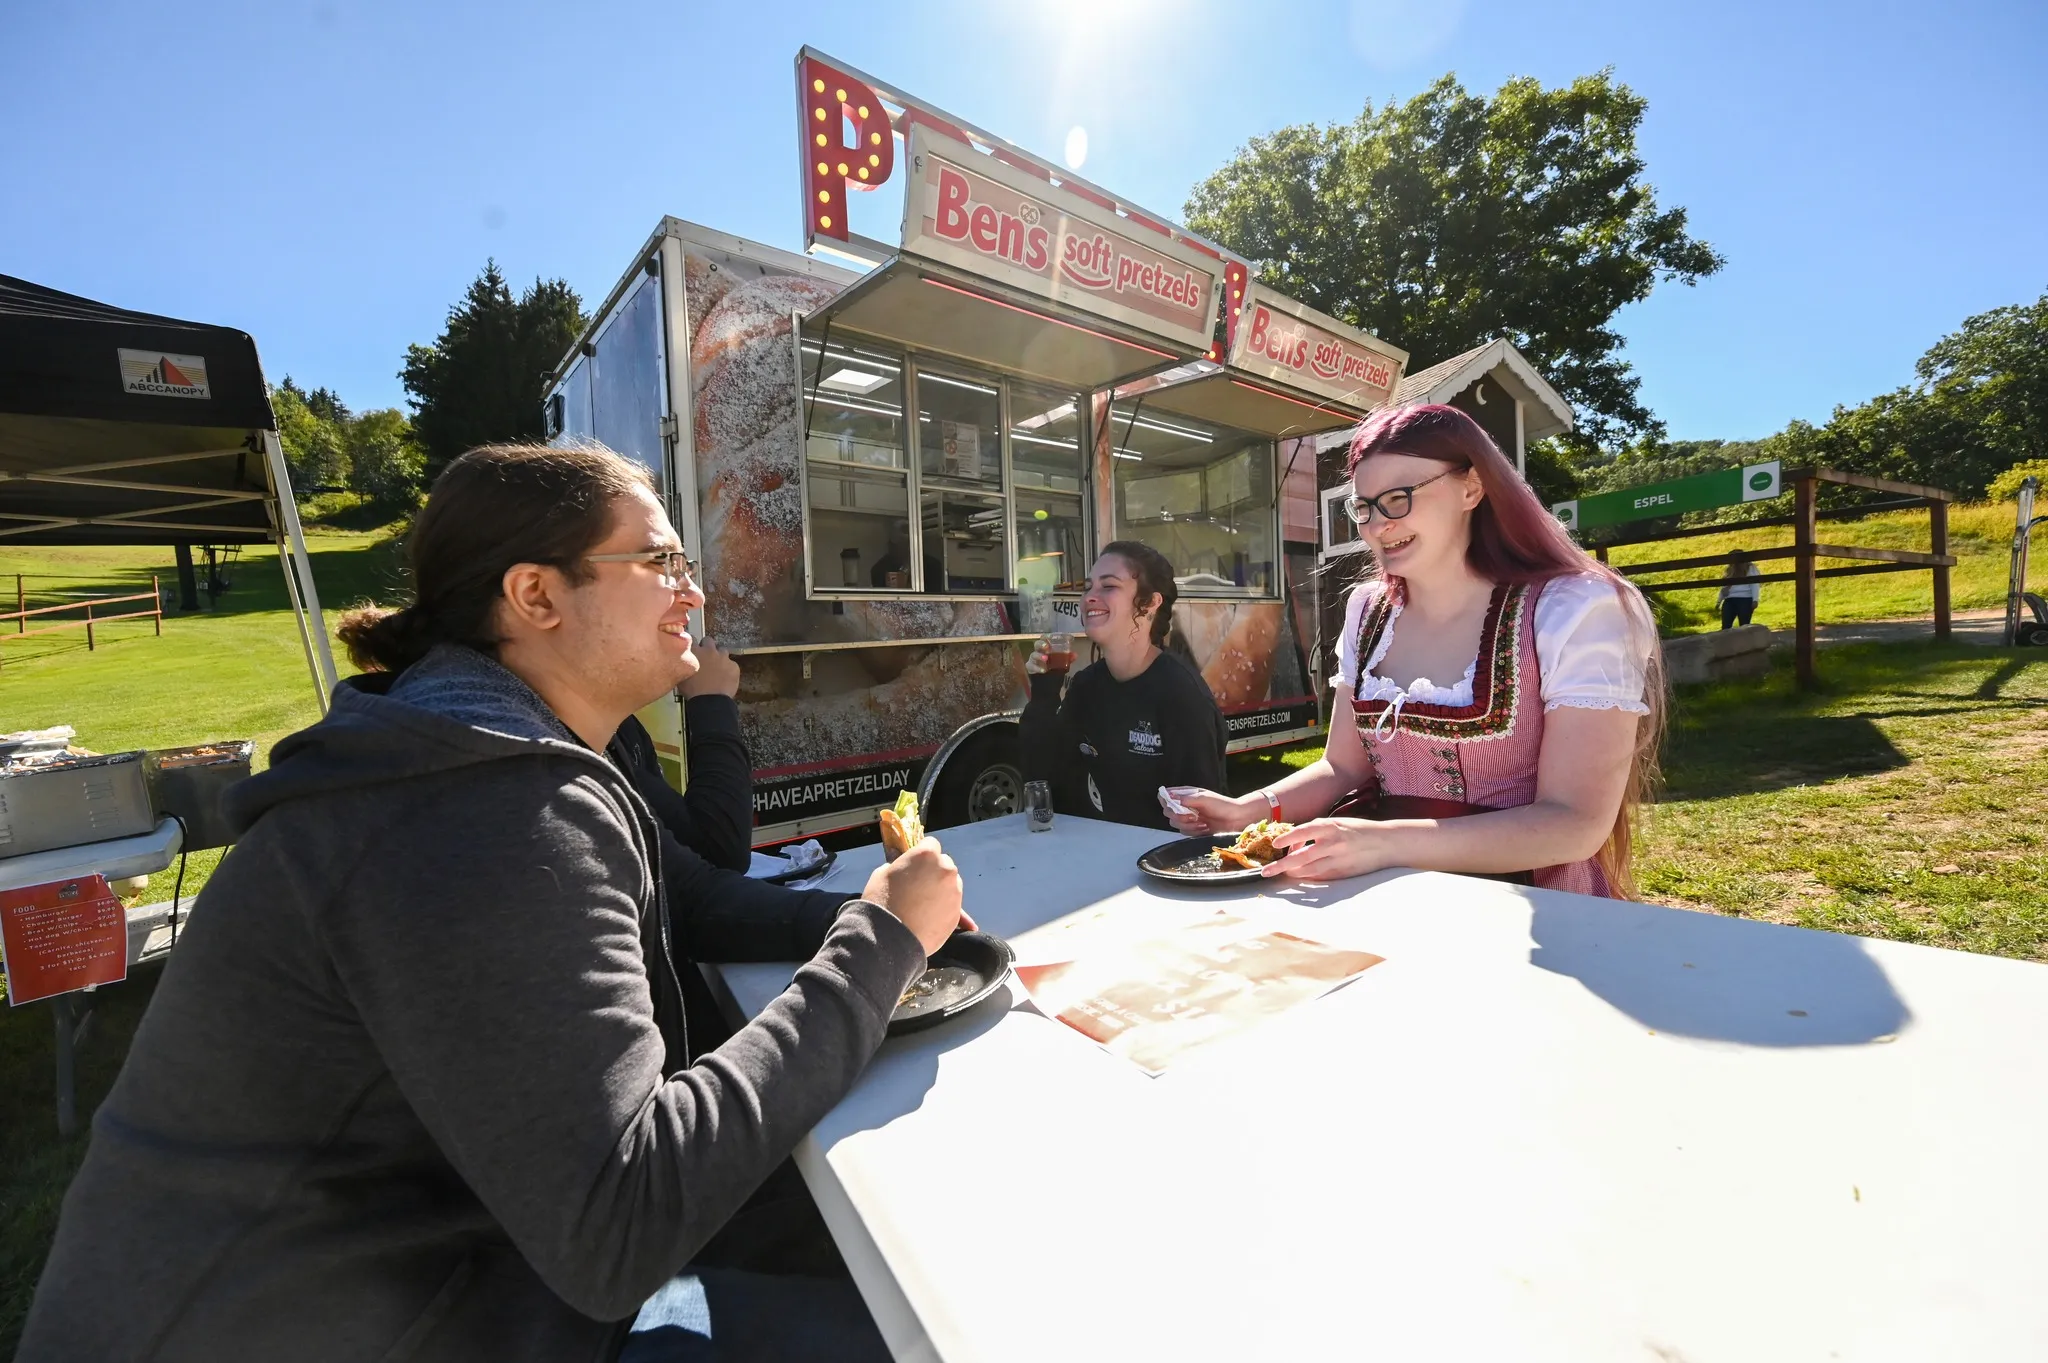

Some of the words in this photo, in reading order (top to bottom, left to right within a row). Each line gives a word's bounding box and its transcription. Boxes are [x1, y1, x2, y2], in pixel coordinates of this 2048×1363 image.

[1063, 233, 1112, 275] soft
[1115, 253, 1201, 310] pretzels
[1314, 340, 1343, 370] soft
[1341, 355, 1390, 388] pretzels
[129, 382, 205, 396] ABCCANOPY
[1633, 493, 1674, 510] ESPEL
[13, 905, 36, 915] FOOD
[25, 909, 68, 921] Hamburger
[57, 913, 83, 922] Burger
[47, 921, 79, 931] W/Chips
[45, 932, 60, 940] dog
[62, 926, 93, 935] W/Chips
[47, 961, 60, 969] for
